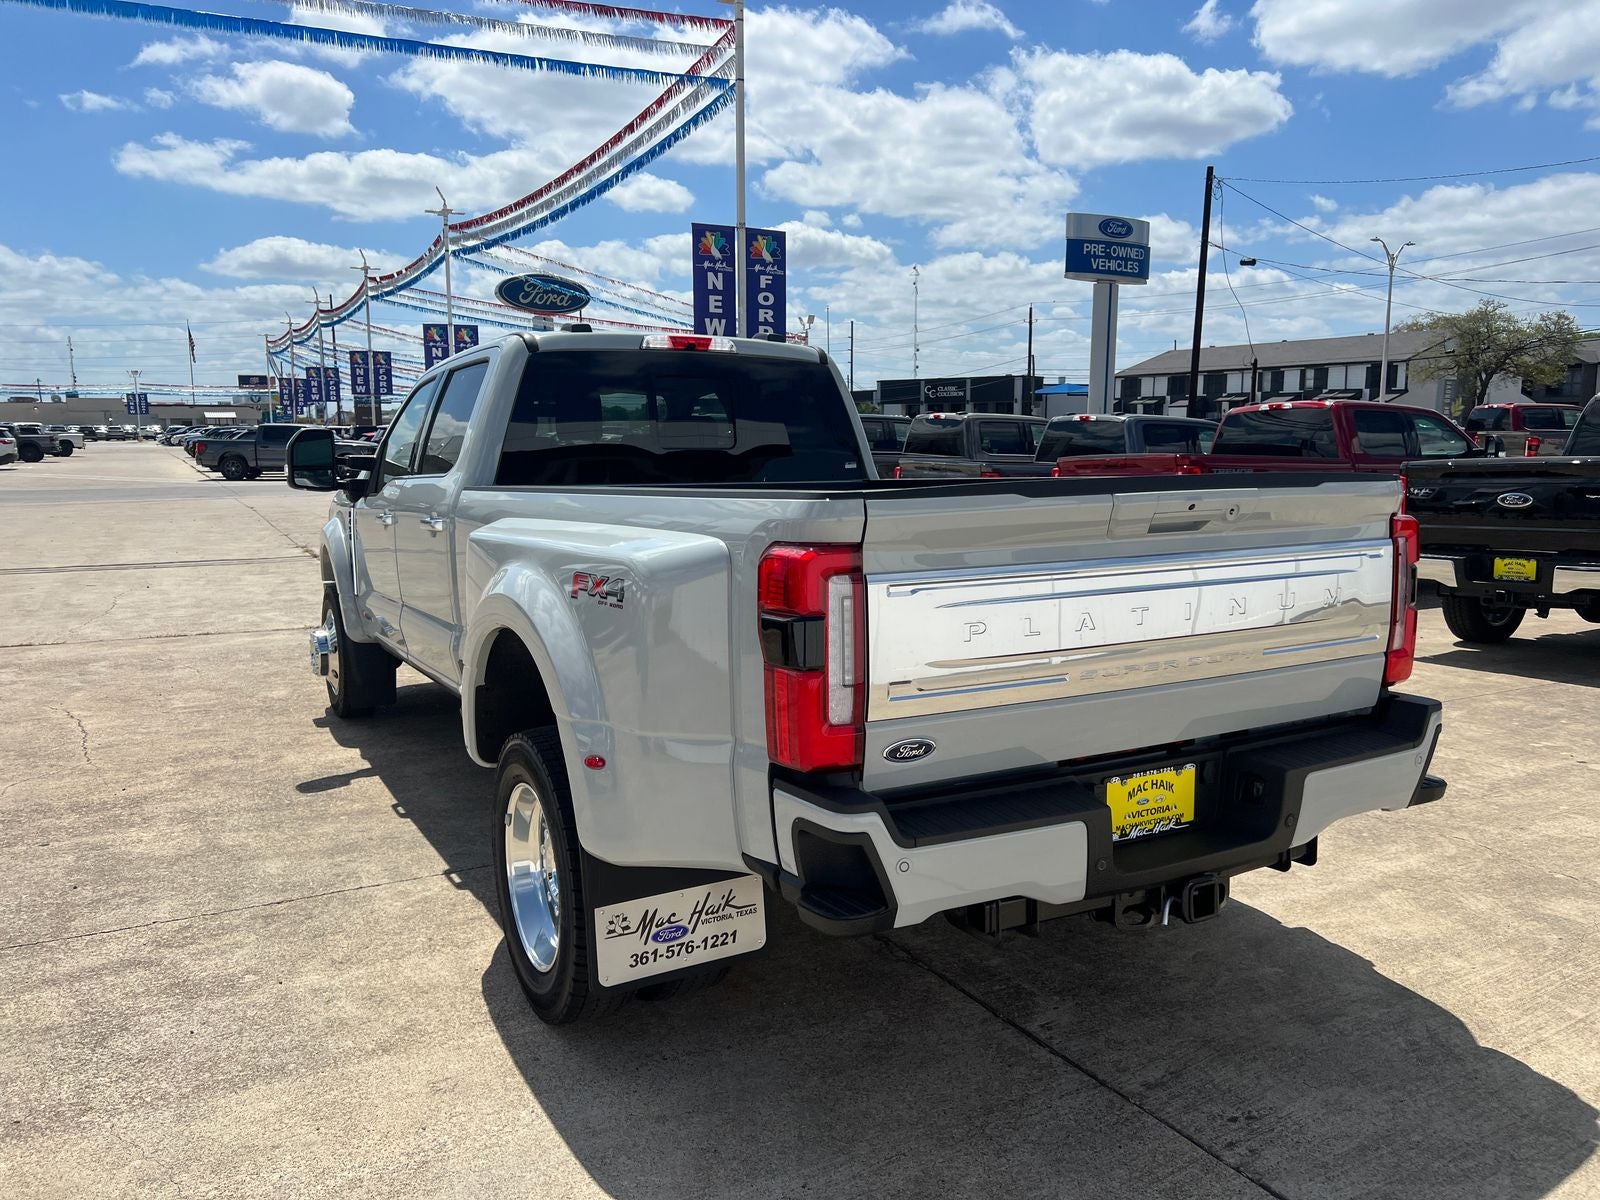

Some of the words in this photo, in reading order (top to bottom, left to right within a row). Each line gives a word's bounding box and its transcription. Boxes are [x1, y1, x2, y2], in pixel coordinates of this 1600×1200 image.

[1107, 221, 1127, 234] Ford
[1083, 243, 1145, 260] PRE-OWNED
[1091, 258, 1139, 273] VEHICLES
[518, 281, 572, 307] Ford
[704, 271, 727, 336] NEW
[757, 275, 775, 335] FORD
[310, 380, 320, 401] NEW
[329, 380, 337, 401] FORD
[355, 368, 366, 393] NEW
[378, 368, 387, 394] FORD
[282, 389, 290, 406] NEW
[1504, 495, 1524, 504] Ford
[571, 571, 625, 602] FX4
[964, 587, 1342, 643] PLATINUM
[1079, 659, 1180, 681] SUPER
[896, 743, 926, 758] Ford
[1128, 781, 1149, 801] MAC
[1151, 779, 1175, 793] HAIK
[1132, 804, 1170, 820] VICTORIA
[635, 908, 684, 945] Mac
[688, 888, 756, 934] Haik
[701, 912, 735, 926] VICTORIA,
[736, 906, 758, 918] TEXAS
[657, 927, 685, 942] Ford
[628, 929, 738, 968] 361-576-1221
